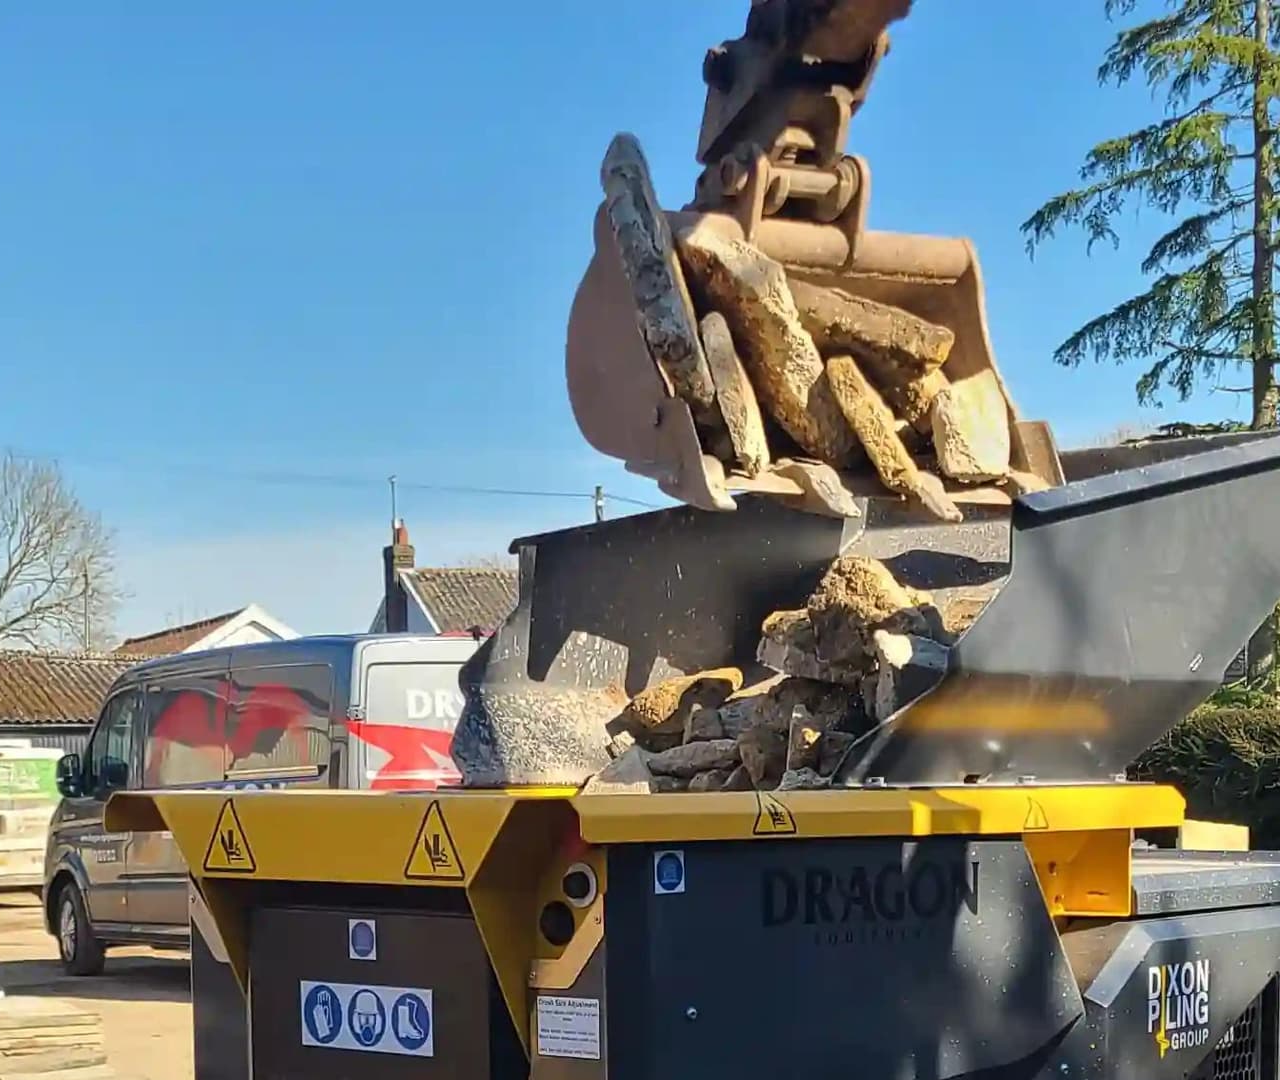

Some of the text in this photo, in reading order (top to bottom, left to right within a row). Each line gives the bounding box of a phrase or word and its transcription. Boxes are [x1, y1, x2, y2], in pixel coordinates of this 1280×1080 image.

[761, 861, 980, 928] DRAGON
[1148, 959, 1210, 1000] DIXON
[1148, 992, 1209, 1033] PILING
[1171, 1028, 1209, 1050] GROUP
